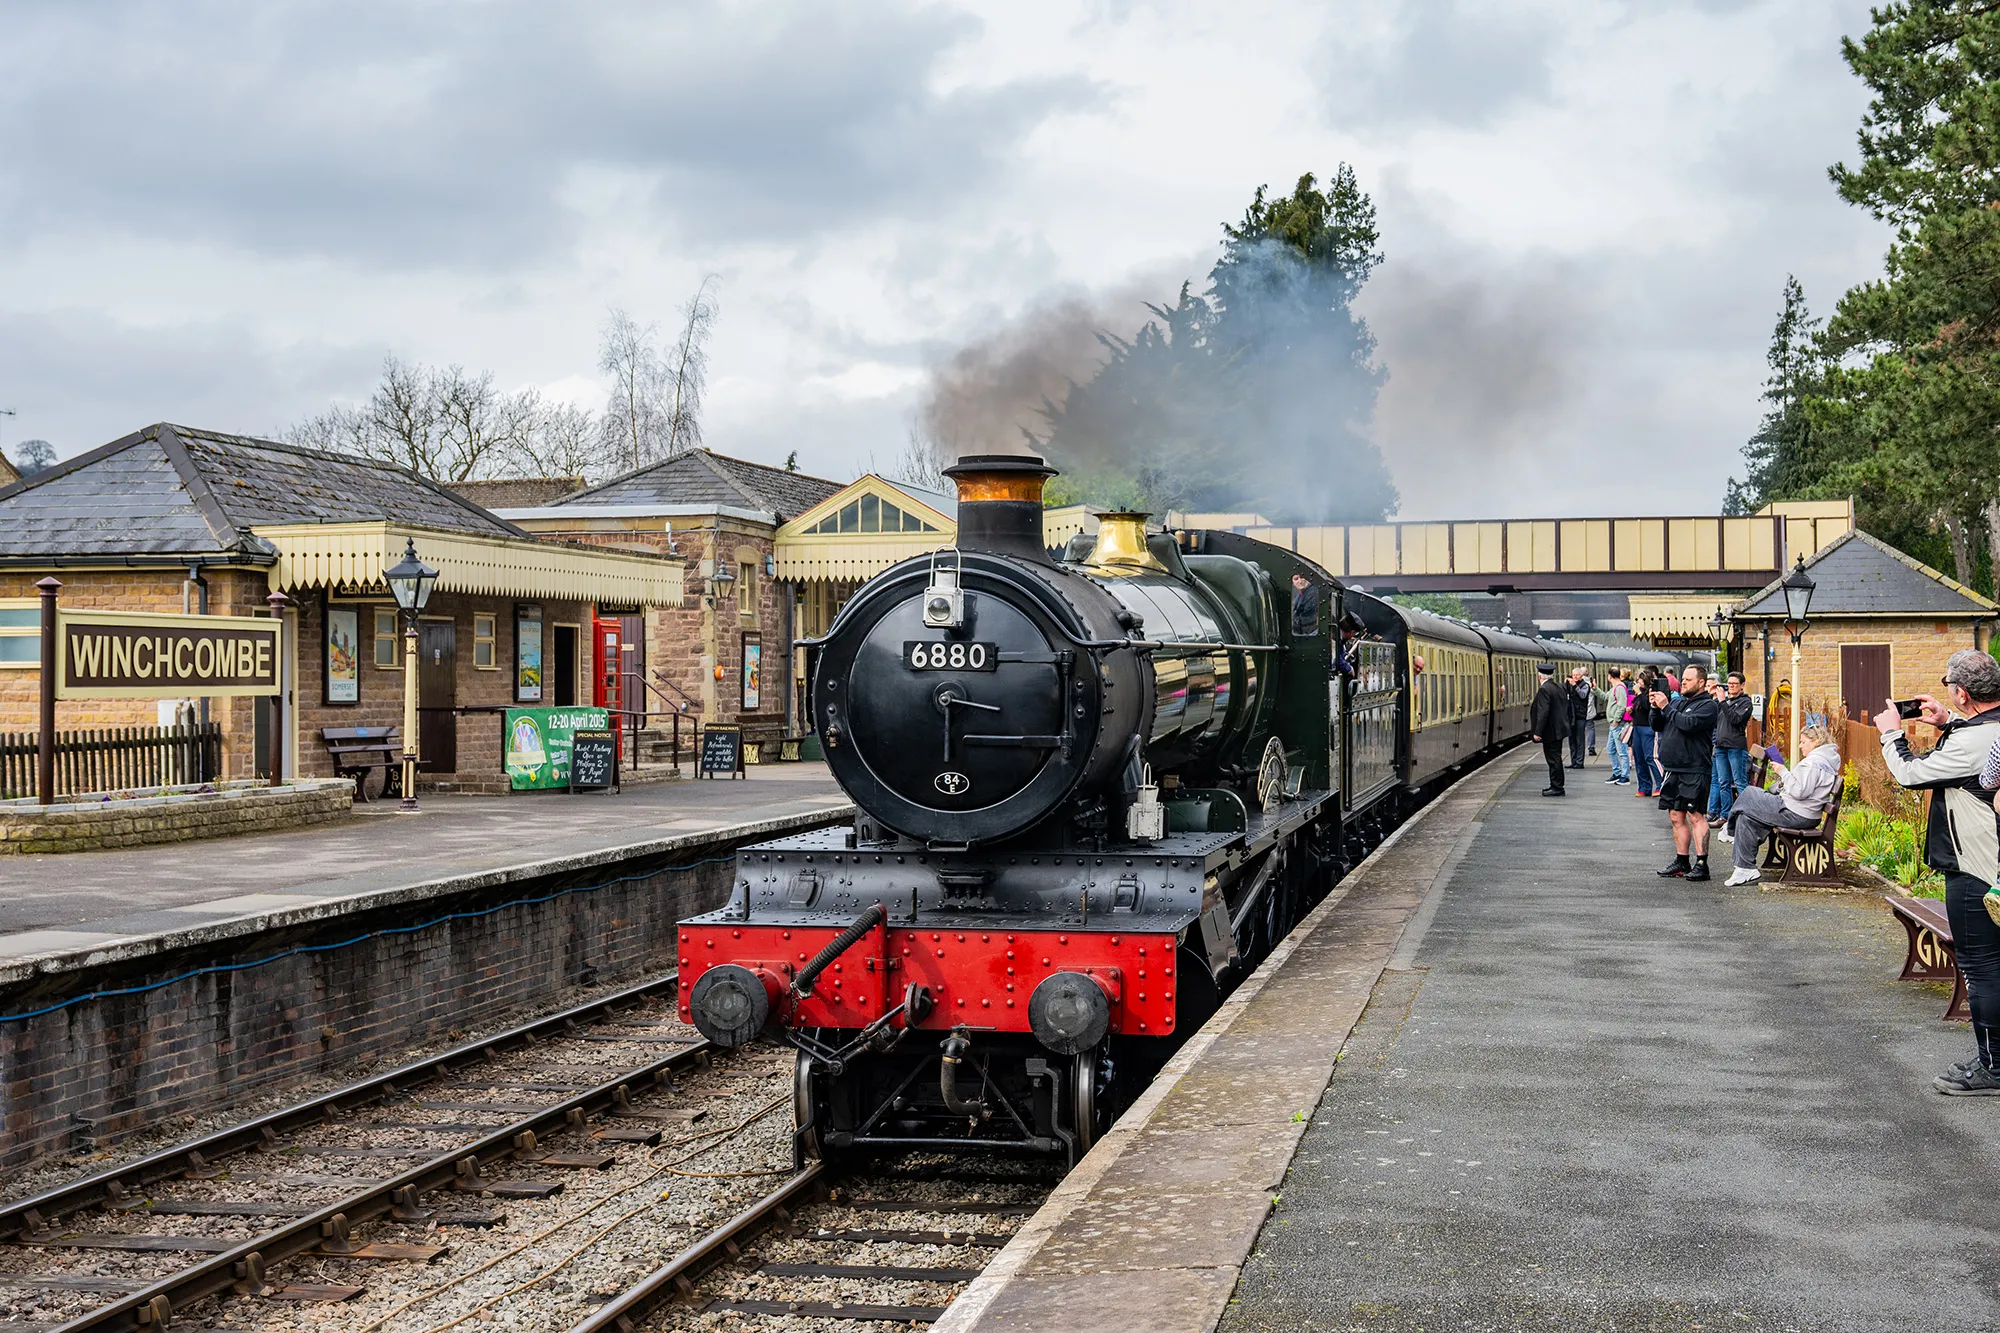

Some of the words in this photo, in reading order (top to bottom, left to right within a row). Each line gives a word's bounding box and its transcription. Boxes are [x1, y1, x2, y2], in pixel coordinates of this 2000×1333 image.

[340, 584, 392, 595] GENTLEM
[602, 602, 637, 611] LADIES
[71, 634, 271, 678] WINCHCOMBE
[911, 642, 986, 669] 6880
[1753, 695, 1761, 704] 12
[548, 714, 569, 729] 12-20
[570, 713, 588, 731] April
[574, 743, 591, 752] Model
[593, 743, 612, 755] Railway
[582, 751, 594, 761] Open
[576, 759, 596, 768] Platform
[597, 759, 603, 768] 2
[588, 766, 604, 779] Royal
[944, 774, 960, 785] 84
[950, 784, 956, 793] E
[1794, 843, 1830, 875] GWR
[1916, 927, 1954, 969] GW
